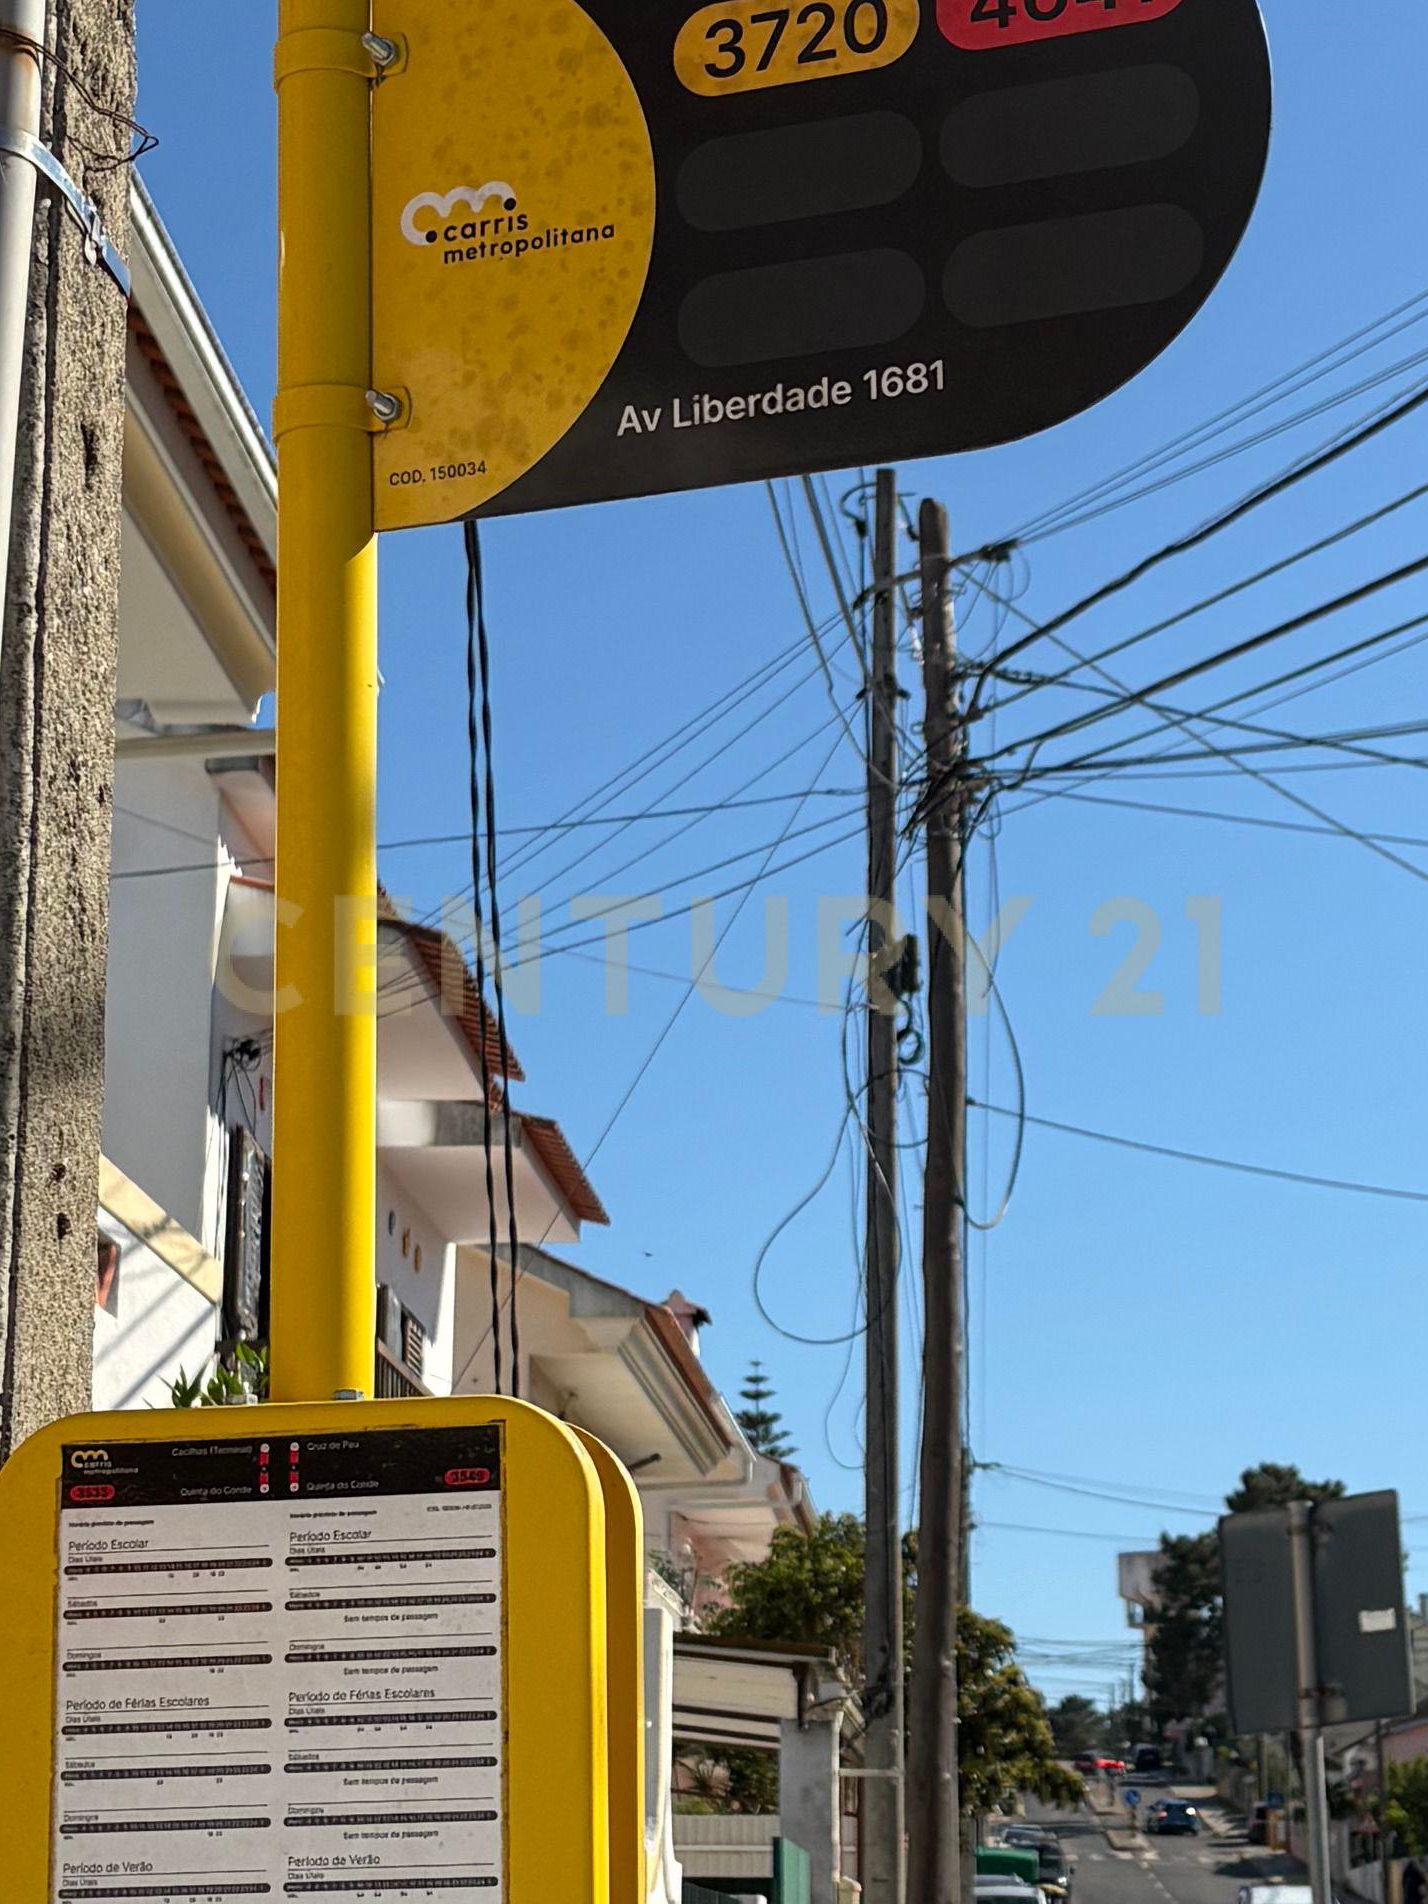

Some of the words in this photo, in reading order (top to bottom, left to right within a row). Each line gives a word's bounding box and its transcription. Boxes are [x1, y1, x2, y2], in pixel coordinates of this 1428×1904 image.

[443, 200, 528, 241] carris
[443, 222, 615, 264] metropolitana
[617, 404, 662, 437] Av
[674, 375, 853, 431] Liberdade
[864, 360, 946, 398] 1681
[430, 460, 488, 483] 150034
[290, 1531, 330, 1542] Período
[334, 1530, 371, 1540] Escolar
[69, 1541, 108, 1551] Período
[111, 1539, 149, 1549] Escolar
[289, 1691, 330, 1702] Período
[350, 1689, 381, 1700] Férias
[385, 1688, 435, 1699] Escolares
[66, 1700, 106, 1711] Período
[109, 1700, 122, 1709] de
[125, 1697, 156, 1708] Férias
[159, 1696, 209, 1707] Escolares
[63, 1862, 103, 1874] Período
[106, 1862, 119, 1872] de
[122, 1861, 153, 1872] Verão
